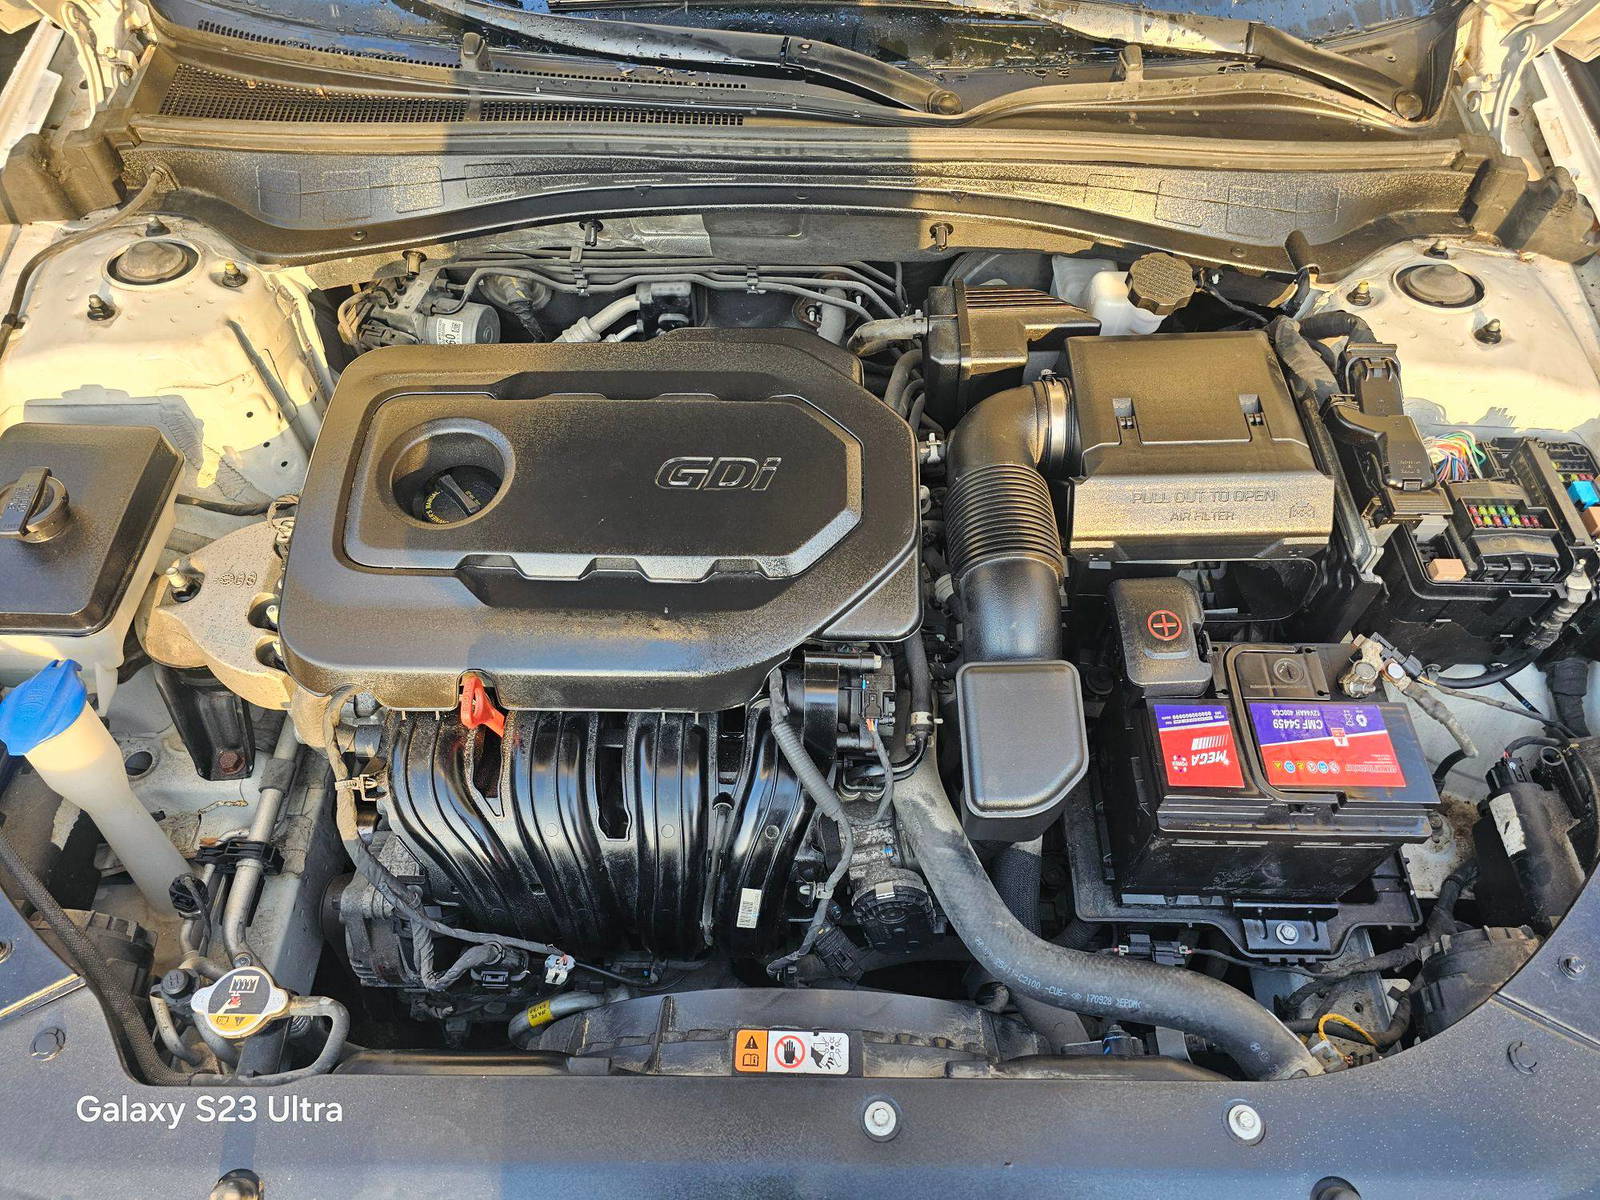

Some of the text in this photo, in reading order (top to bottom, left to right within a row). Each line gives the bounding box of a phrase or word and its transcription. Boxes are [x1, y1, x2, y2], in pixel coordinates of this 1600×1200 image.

[655, 456, 782, 491] GDi
[1132, 489, 1277, 504] PULL OUT TO OPEN
[1170, 510, 1235, 522] AIR FILTER
[1272, 717, 1323, 730] CMF 54459
[1191, 749, 1229, 767] MEGA
